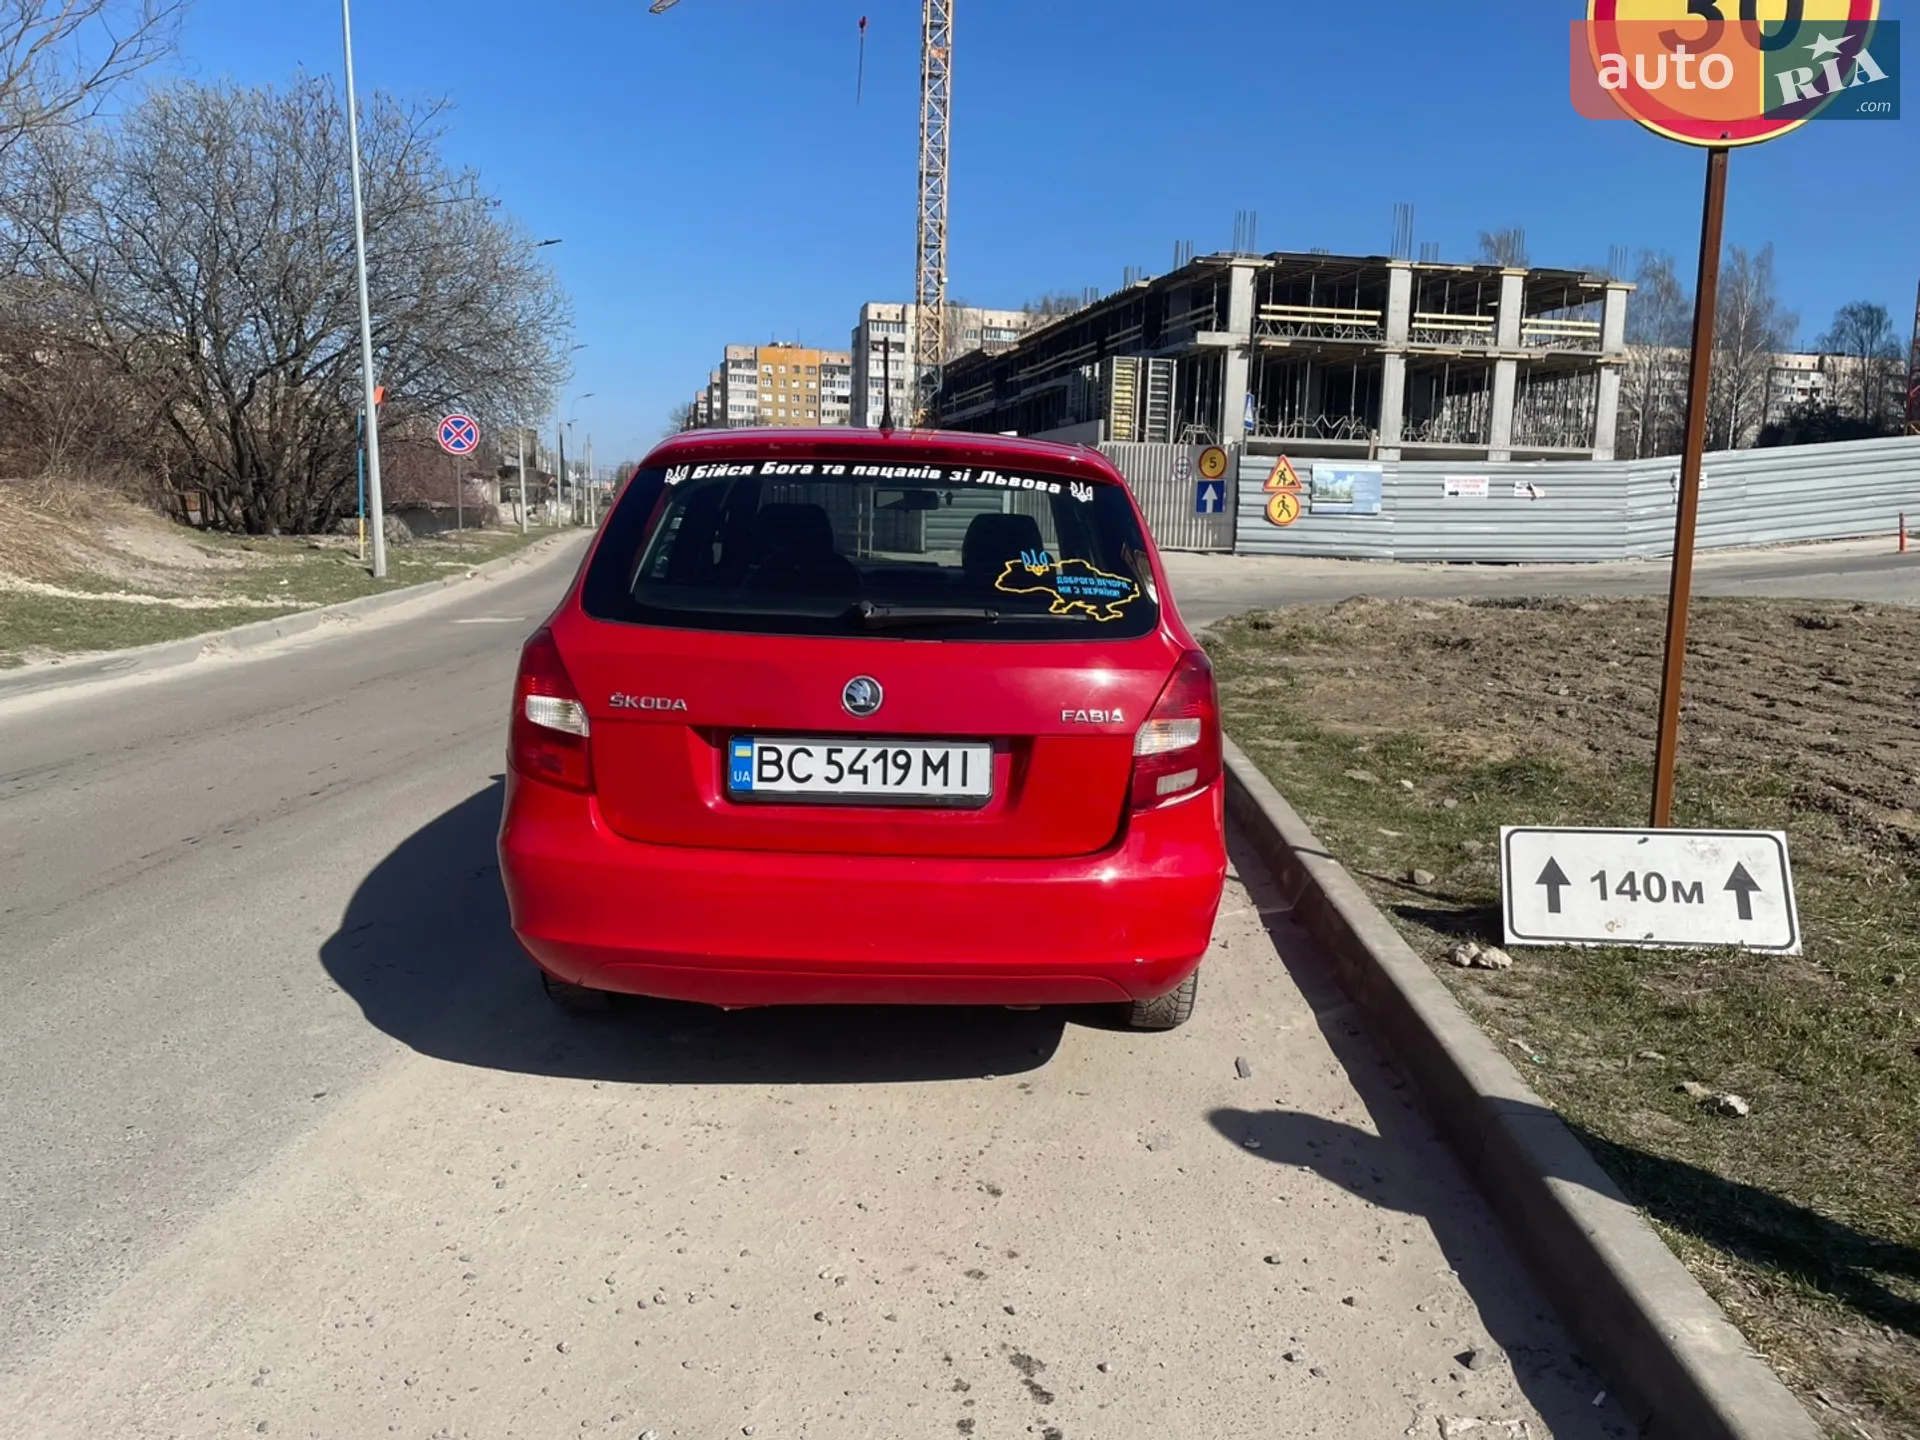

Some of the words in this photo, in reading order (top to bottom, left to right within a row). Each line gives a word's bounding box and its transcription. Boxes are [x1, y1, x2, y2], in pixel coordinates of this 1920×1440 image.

[1209, 456, 1217, 469] 5
[691, 463, 754, 479] Бійся
[760, 461, 814, 475] Бога
[821, 464, 846, 475] та
[852, 465, 941, 479] пацанів
[949, 469, 971, 482] зі
[976, 470, 1061, 493] Львова
[609, 692, 688, 711] ŠKODA
[1061, 708, 1125, 723] FABIA
[757, 746, 814, 784] BC
[824, 747, 912, 786] 5419
[922, 749, 968, 788] MI
[733, 770, 751, 783] UA
